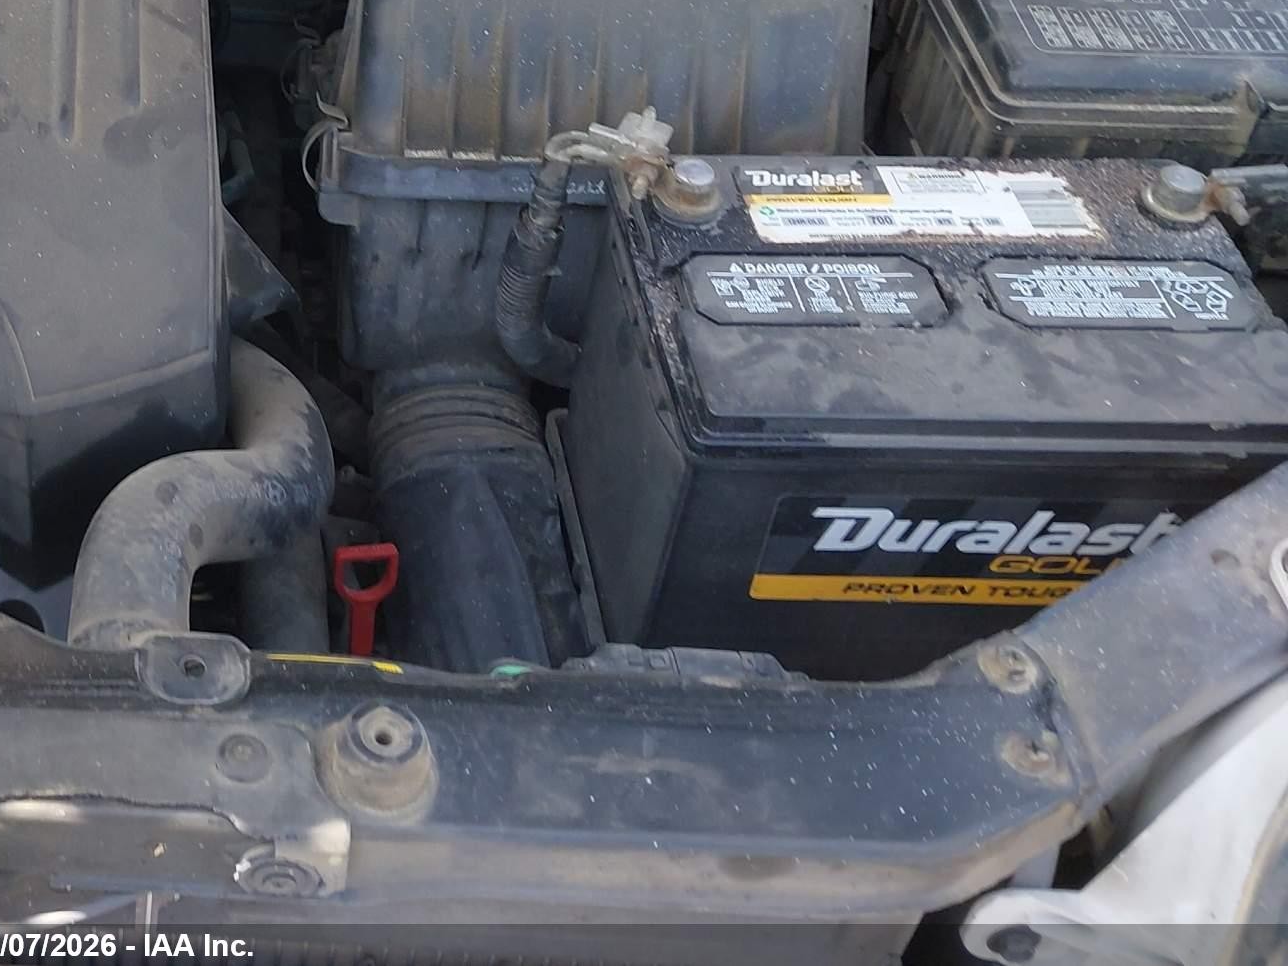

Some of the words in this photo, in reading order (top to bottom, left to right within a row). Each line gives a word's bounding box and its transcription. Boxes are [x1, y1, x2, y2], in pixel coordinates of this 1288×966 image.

[744, 170, 862, 187] Duralast
[870, 214, 893, 226] 700
[745, 263, 809, 274] DANGER
[824, 263, 881, 274] POISON
[812, 507, 1182, 555] Duralast
[989, 556, 1121, 575] GOL
[842, 582, 973, 596] PROVEN
